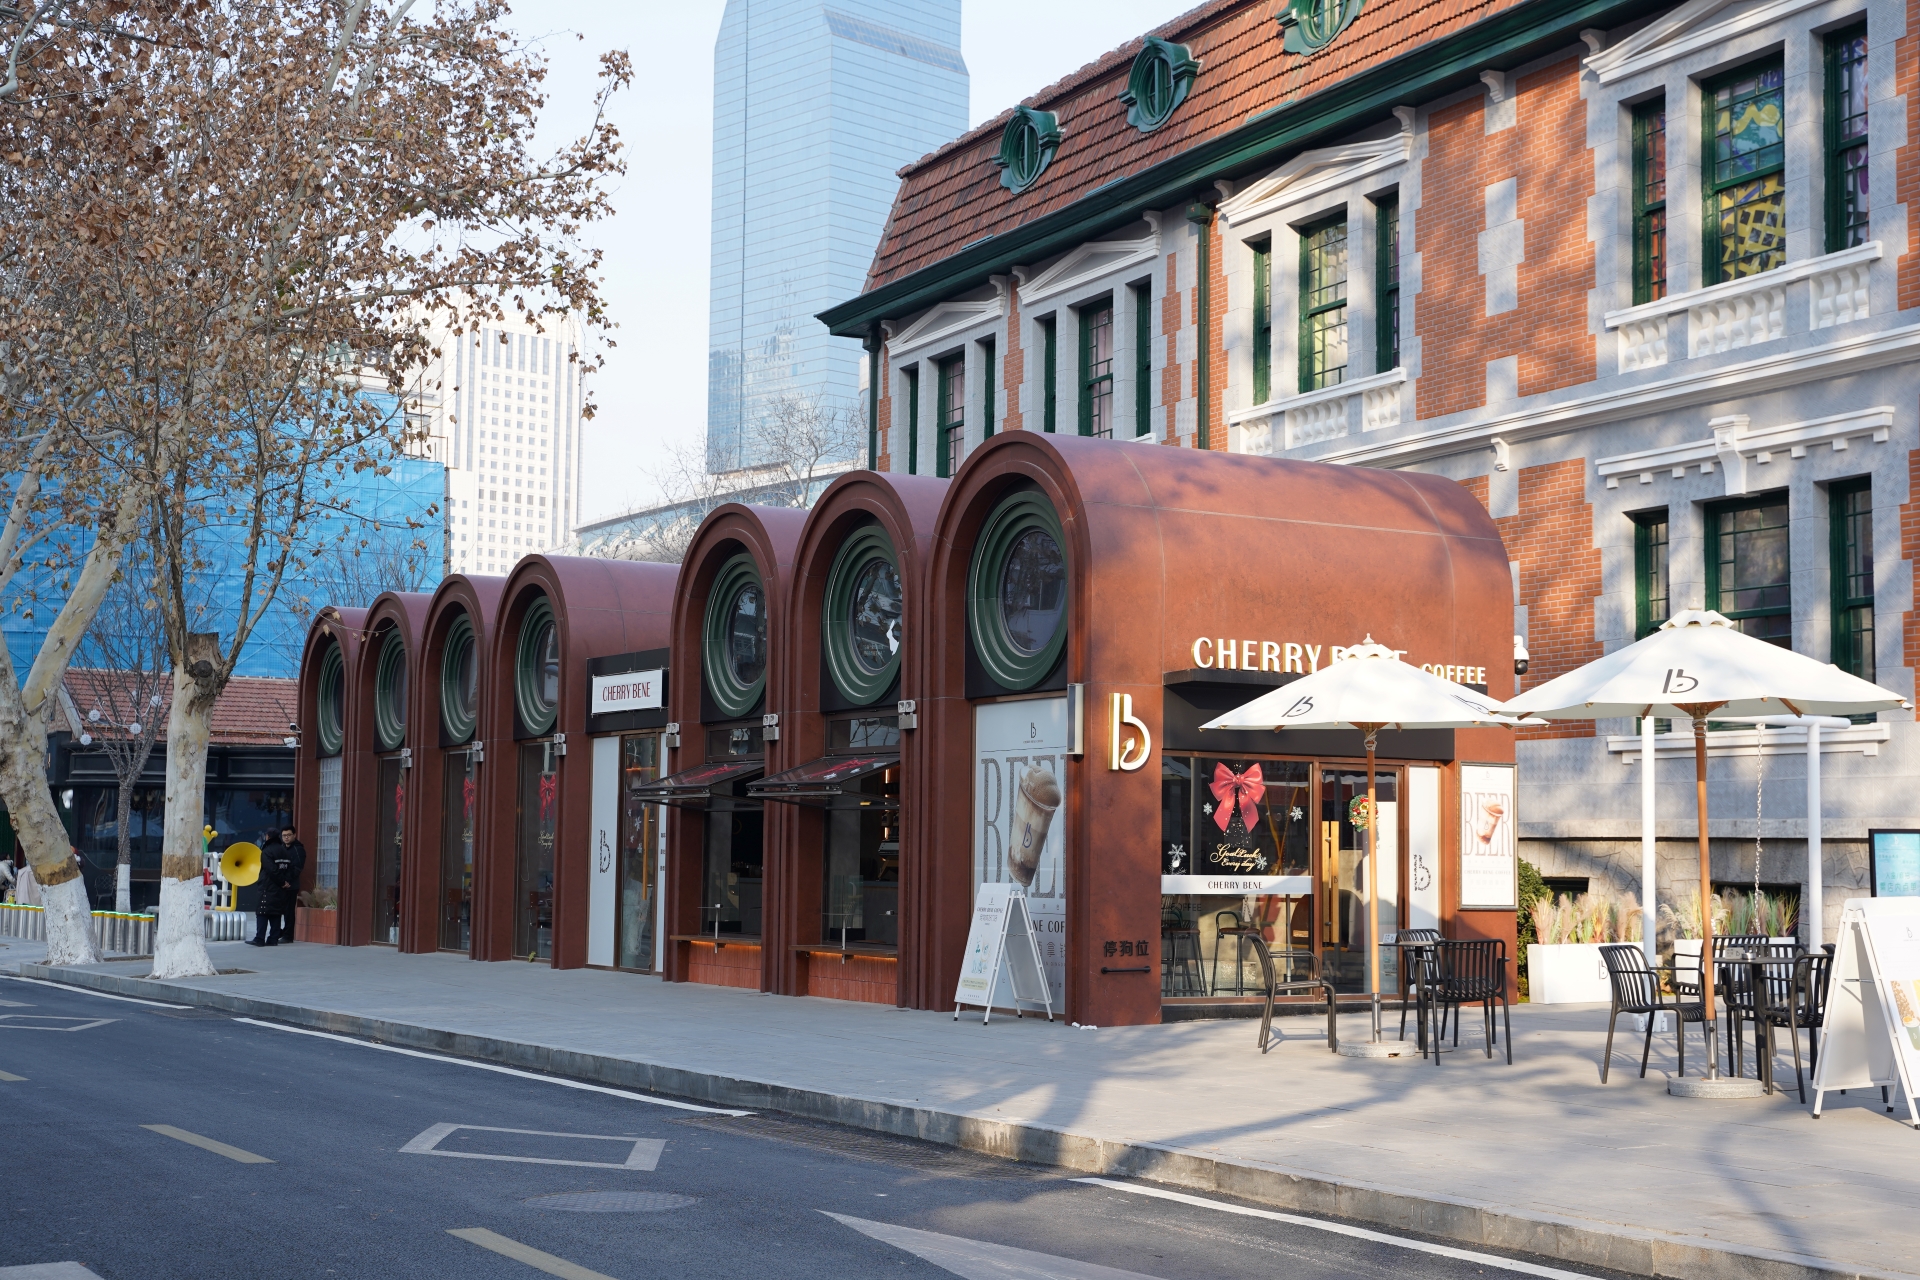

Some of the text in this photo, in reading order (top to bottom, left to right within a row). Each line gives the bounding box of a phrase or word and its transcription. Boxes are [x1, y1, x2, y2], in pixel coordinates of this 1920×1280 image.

[1192, 637, 1322, 674] CHERRY
[1420, 663, 1487, 685] COFFEE
[603, 681, 651, 701] CHERRY BENE
[1207, 880, 1263, 890] CHERRY BENE
[1030, 919, 1066, 934] NE COF
[1103, 940, 1150, 957] 停狗位
